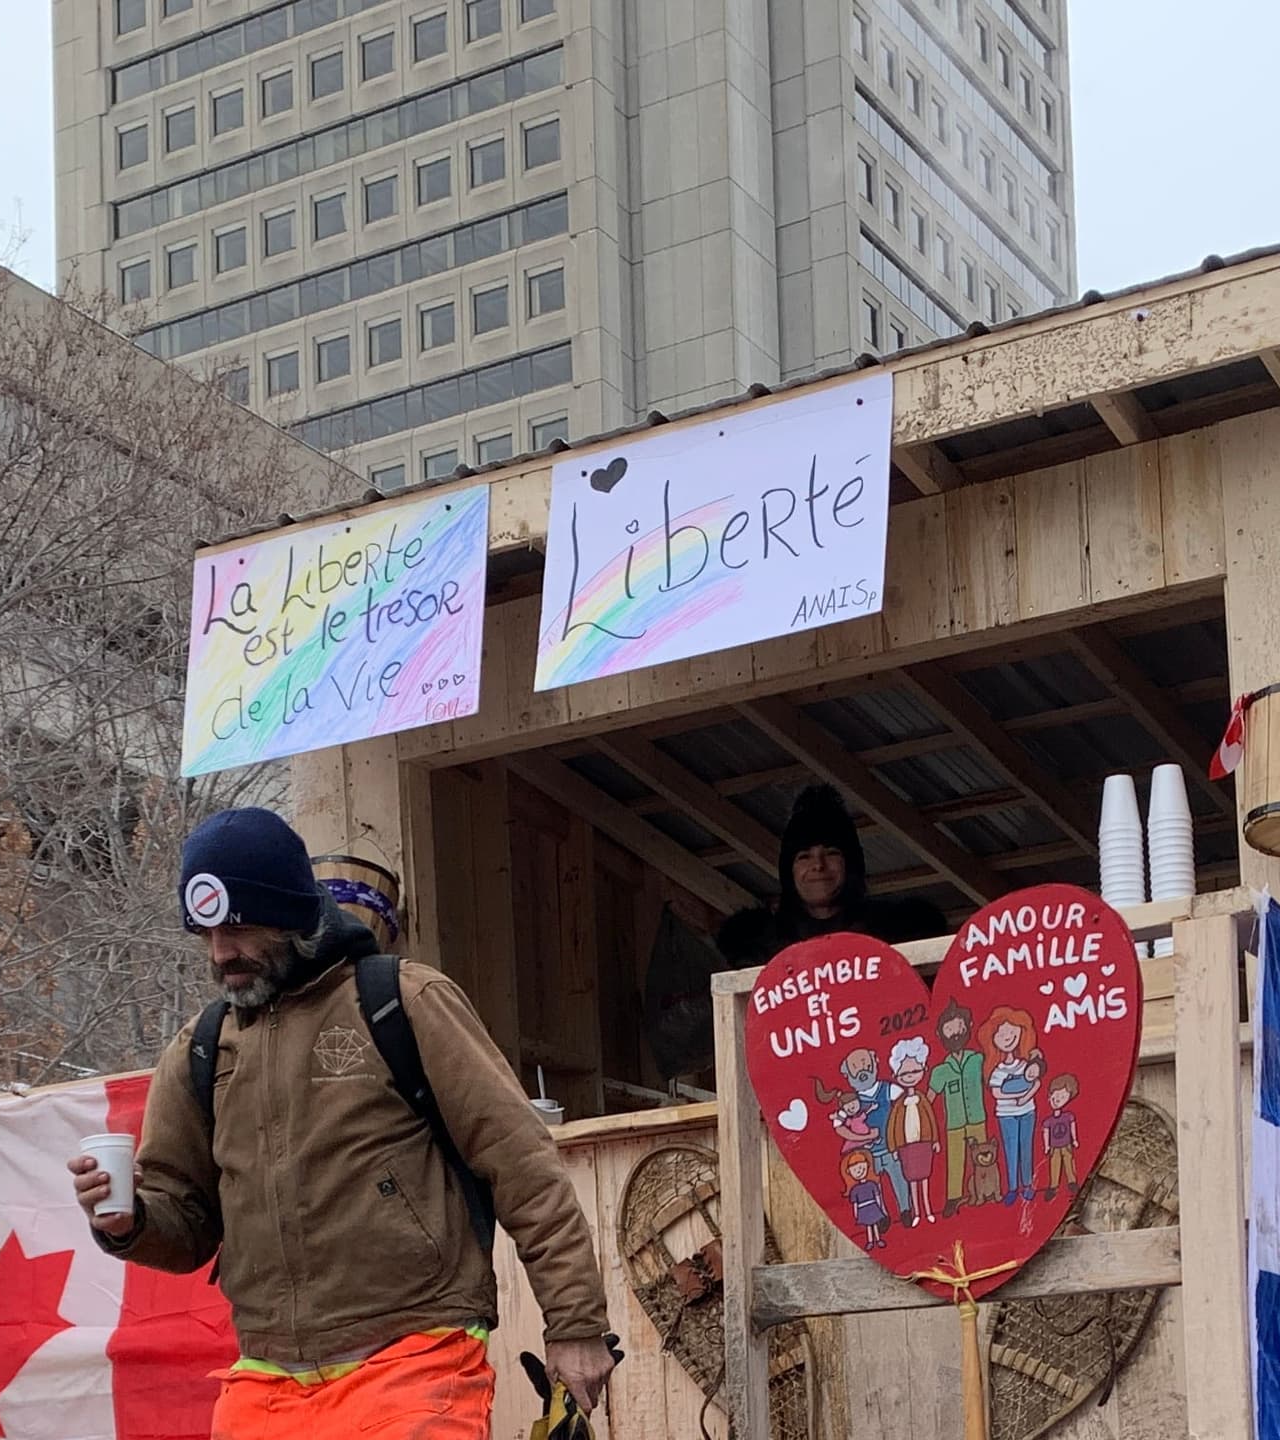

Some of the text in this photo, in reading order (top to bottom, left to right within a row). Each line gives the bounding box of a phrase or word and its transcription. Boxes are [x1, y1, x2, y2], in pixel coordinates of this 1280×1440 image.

[203, 564, 257, 635] La
[243, 618, 294, 666] est
[321, 604, 349, 650] le
[211, 685, 263, 740] de
[283, 673, 315, 725] la
[965, 902, 1086, 953] AMOUR
[753, 956, 882, 1015] ENSEMBLE
[879, 1003, 929, 1036] 2022
